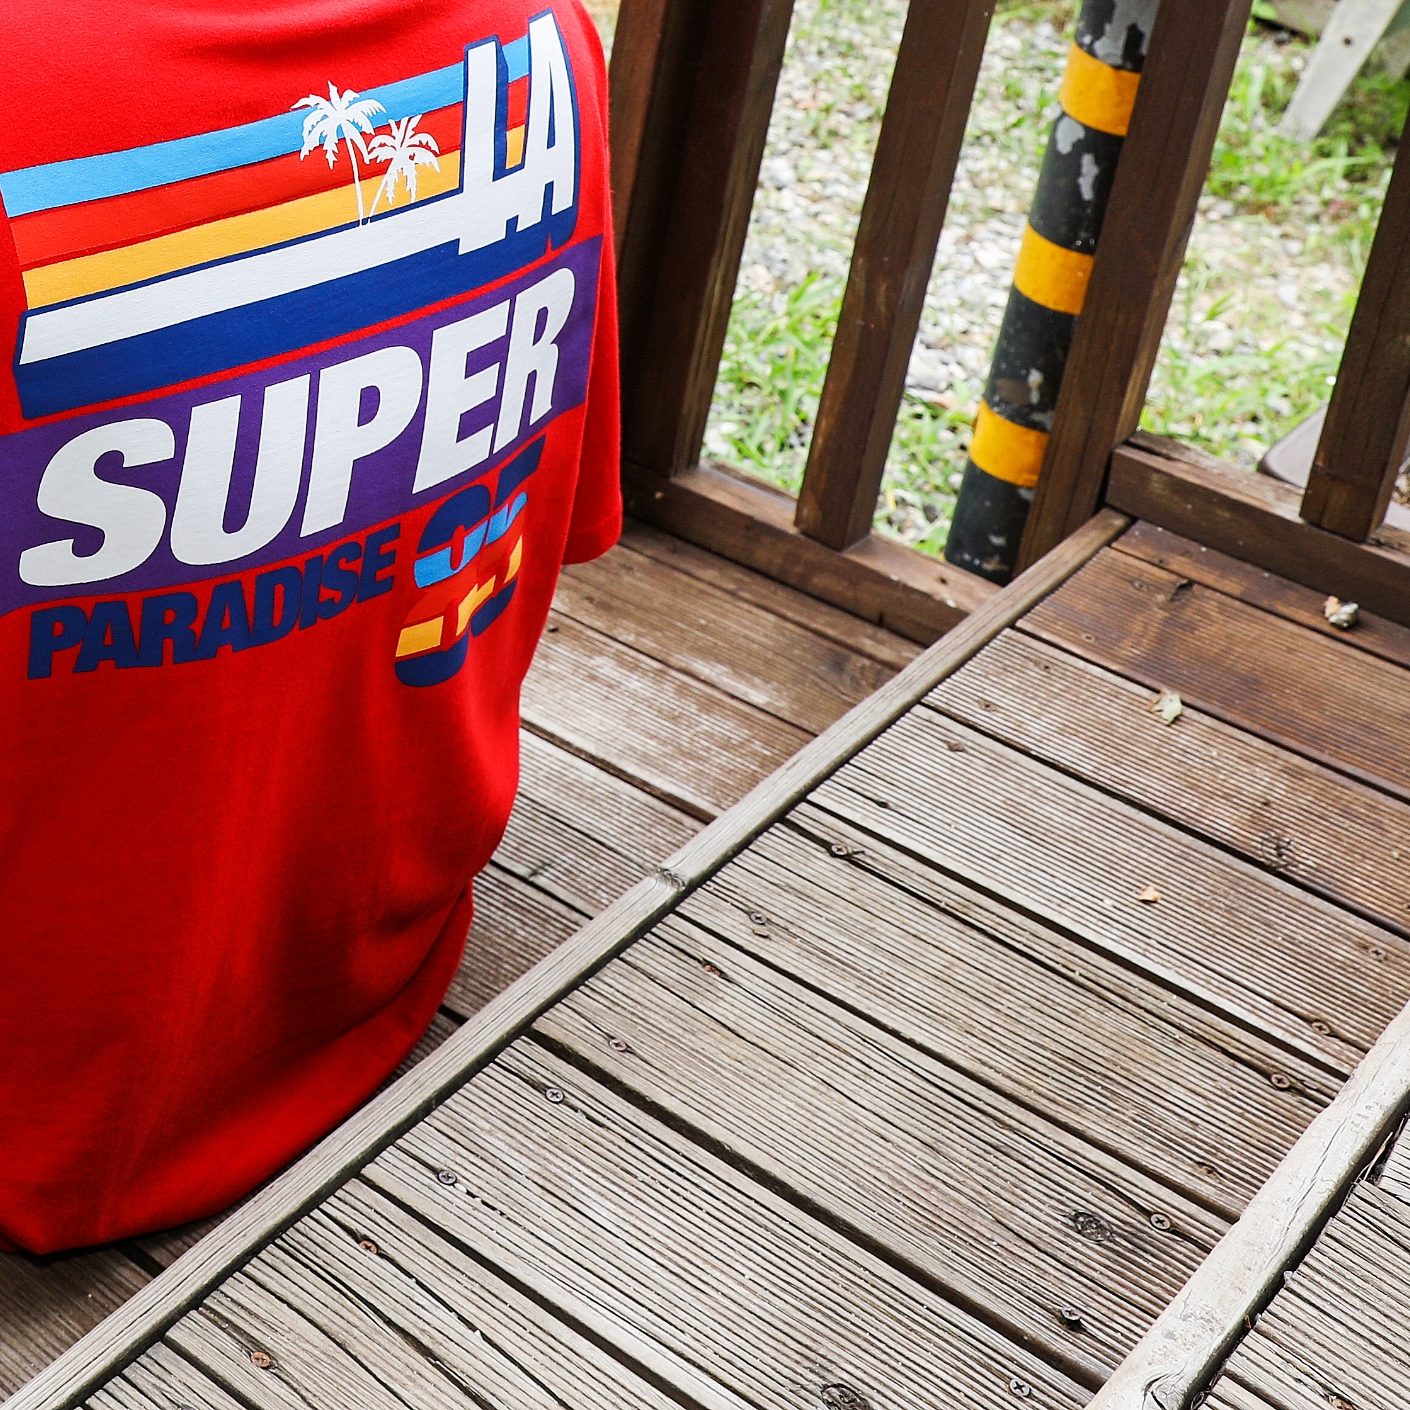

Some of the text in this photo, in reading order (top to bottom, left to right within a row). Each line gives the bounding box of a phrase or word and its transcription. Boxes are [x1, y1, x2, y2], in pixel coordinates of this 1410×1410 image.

[456, 9, 579, 256] LA
[18, 266, 576, 588] SUPER
[27, 520, 401, 680] PARADISE
